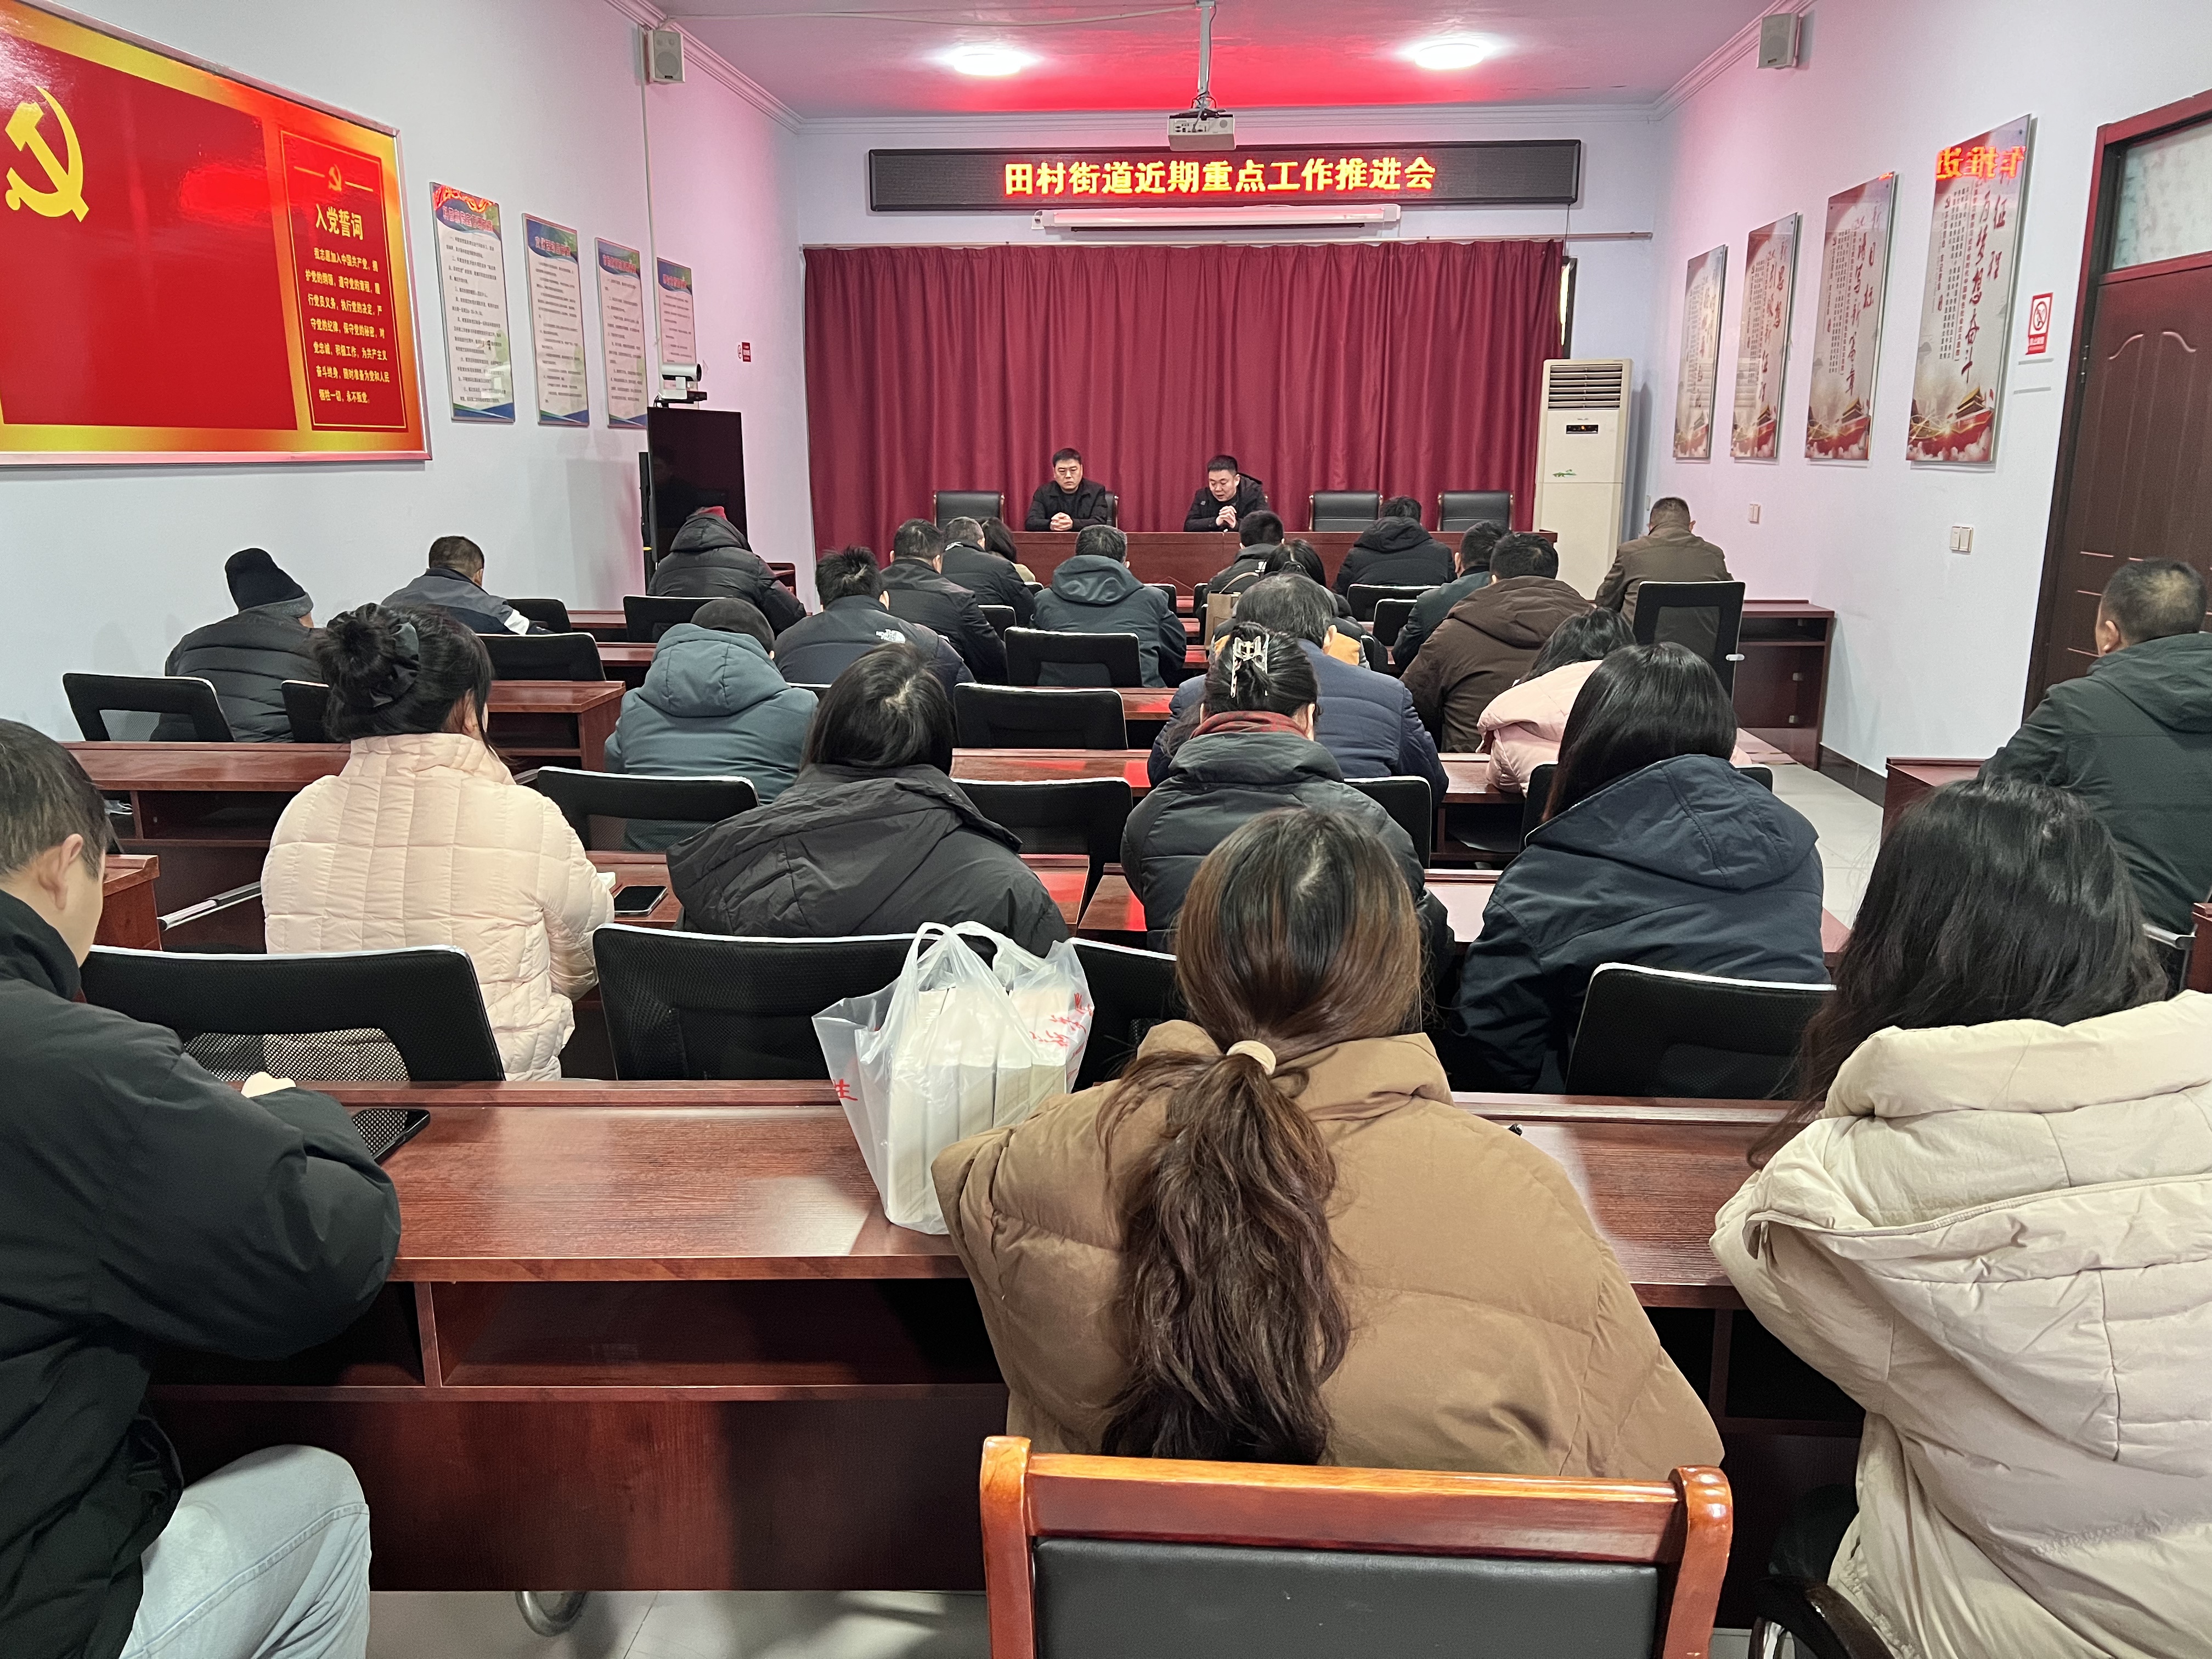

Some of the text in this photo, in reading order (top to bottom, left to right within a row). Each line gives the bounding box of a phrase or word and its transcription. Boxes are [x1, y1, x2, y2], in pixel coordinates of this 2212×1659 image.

[1005, 156, 1435, 194] 田村街道近期重点工作推进会
[315, 204, 363, 240] 入党誓词
